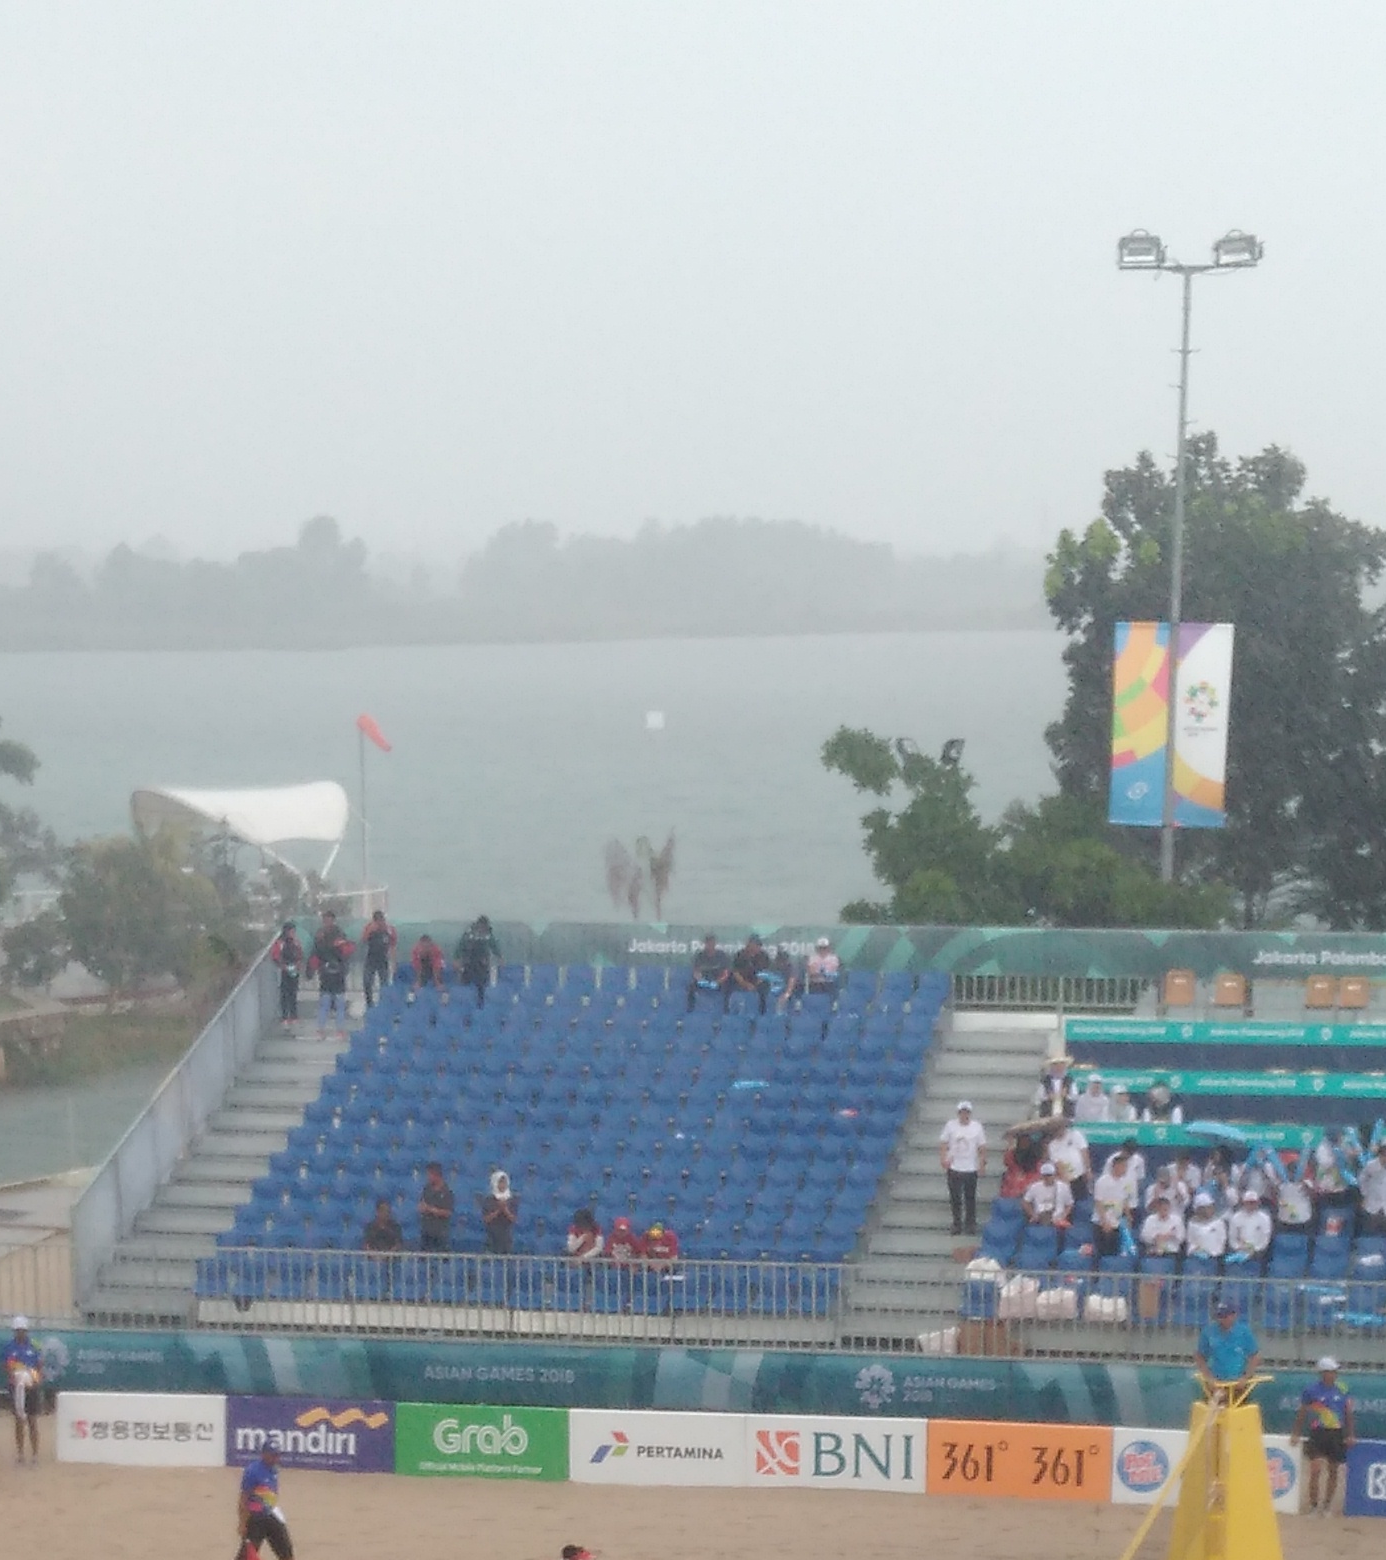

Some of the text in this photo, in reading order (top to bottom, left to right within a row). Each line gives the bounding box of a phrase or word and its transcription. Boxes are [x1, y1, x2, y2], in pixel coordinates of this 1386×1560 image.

[1253, 951, 1316, 965] Jakarta
[424, 1365, 471, 1380] ASIAN
[476, 1367, 534, 1381] GAMES
[236, 1425, 355, 1455] mandiri
[433, 1414, 528, 1455] Grab
[637, 1446, 724, 1459] PERTAMINA
[812, 1432, 914, 1479] BNI
[942, 1440, 1008, 1482] 361°
[1032, 1445, 1100, 1486] 361°
